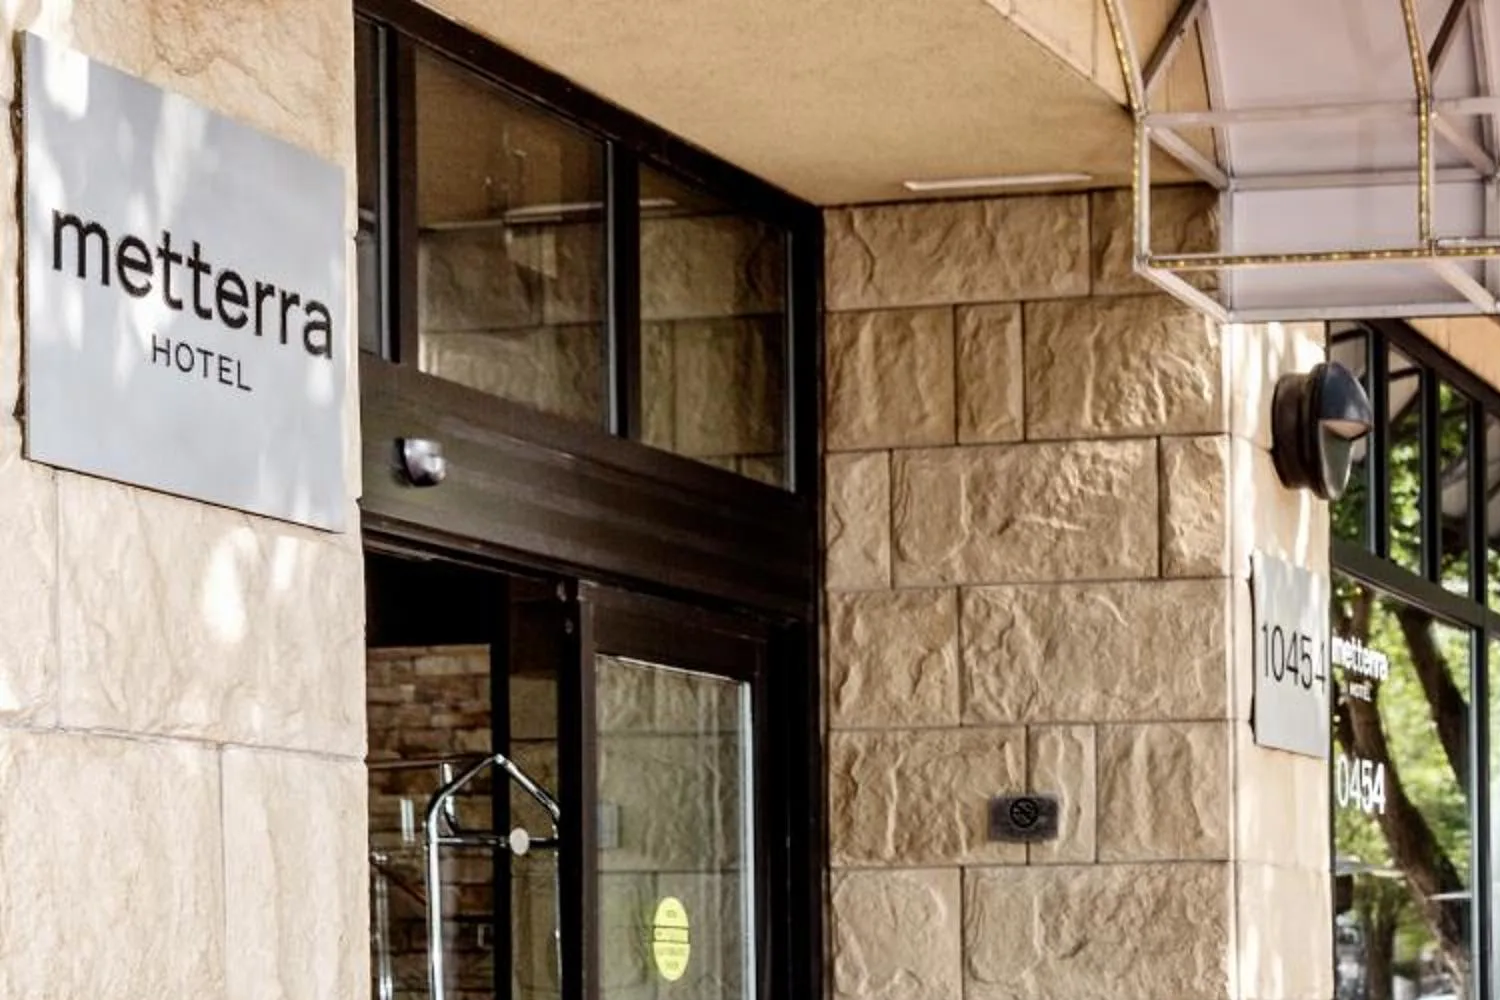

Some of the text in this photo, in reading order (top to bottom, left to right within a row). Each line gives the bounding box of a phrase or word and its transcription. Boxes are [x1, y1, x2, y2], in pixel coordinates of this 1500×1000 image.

[51, 207, 333, 360] metterra
[151, 333, 252, 392] HOTEL
[1261, 622, 1326, 693] 10454
[1336, 753, 1386, 815] 0454
